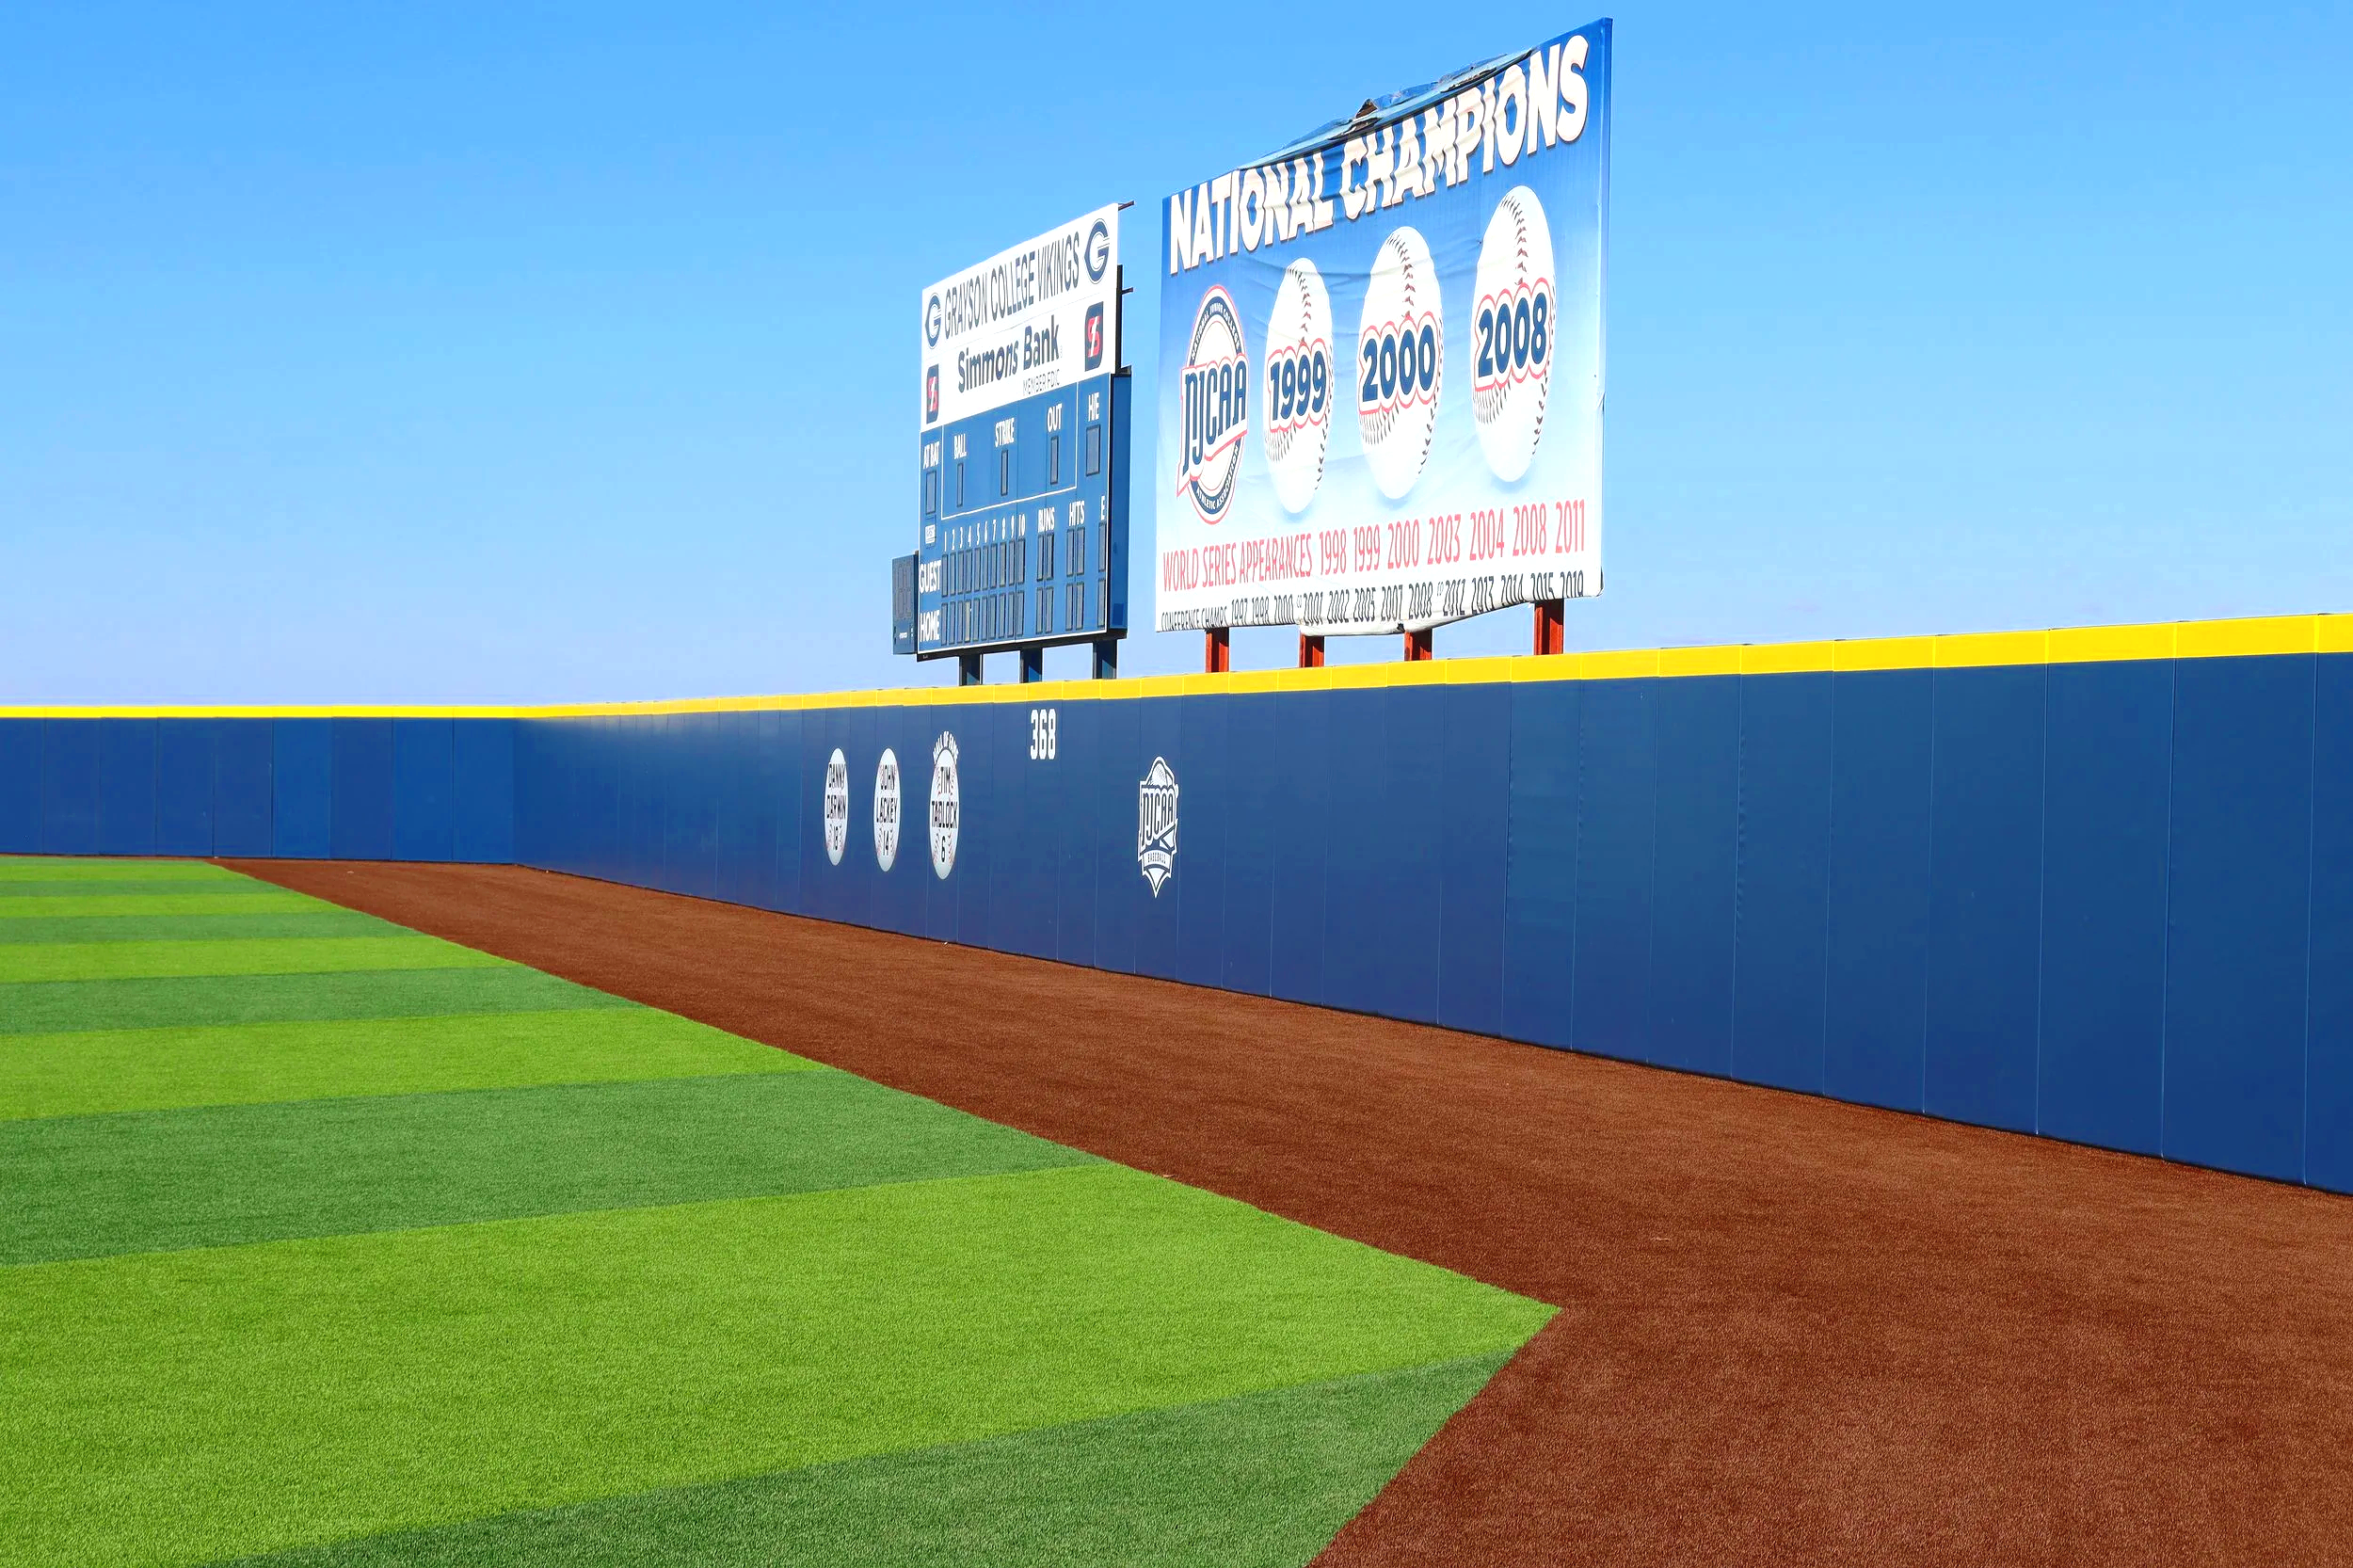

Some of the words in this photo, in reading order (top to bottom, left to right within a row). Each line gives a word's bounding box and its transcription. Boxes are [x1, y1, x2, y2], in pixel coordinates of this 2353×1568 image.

[1170, 152, 1334, 275] NATIONAL
[1339, 35, 1589, 220] CHAMPIONS
[944, 272, 987, 340] GRAYSON
[991, 250, 1034, 321] COLLEGE
[1038, 232, 1080, 301] VIKINGS
[958, 341, 1018, 393] Simmons
[1023, 314, 1060, 371] Bank
[1479, 292, 1548, 377] 2008
[1023, 374, 1046, 396] MEMBER
[1048, 369, 1060, 388] FDIC
[1271, 350, 1326, 422] 1999
[1362, 324, 1435, 403] 2000
[995, 417, 1015, 447] STRIKE
[1047, 403, 1062, 432] OUT
[1182, 360, 1247, 476] NJCAA
[953, 434, 967, 459] BALL
[1018, 513, 1025, 536] 10
[1038, 507, 1055, 533] RUNS
[1068, 500, 1084, 527] HITS
[1163, 549, 1199, 591] WORLD
[1203, 542, 1237, 587] SERIES
[1240, 533, 1312, 584] APPEARANCES
[1320, 528, 1346, 575] 1998
[1353, 524, 1380, 572] 1999
[1388, 520, 1419, 568] 2000
[1428, 514, 1461, 565] 2003
[1470, 508, 1504, 561] 2004
[1513, 503, 1546, 556] 2008
[1556, 499, 1585, 553] 2011
[919, 560, 941, 593] GUEST
[920, 610, 940, 642] HOME
[1161, 609, 1200, 632] CONFERENCE
[1201, 606, 1228, 628] CHAMPS
[1231, 598, 1248, 626] 1997
[1252, 595, 1270, 625] 1998
[1274, 594, 1296, 624] 2000
[1304, 591, 1323, 626] 2001
[1327, 589, 1350, 624] 2002
[1381, 584, 1403, 621] 2007
[1408, 582, 1433, 619] 2008
[1443, 579, 1465, 616] 2012
[1030, 708, 1056, 760] 368
[940, 766, 951, 793] TIM
[883, 830, 888, 856] 14
[1142, 792, 1174, 847] NJCAA
[942, 836, 946, 862] 6
